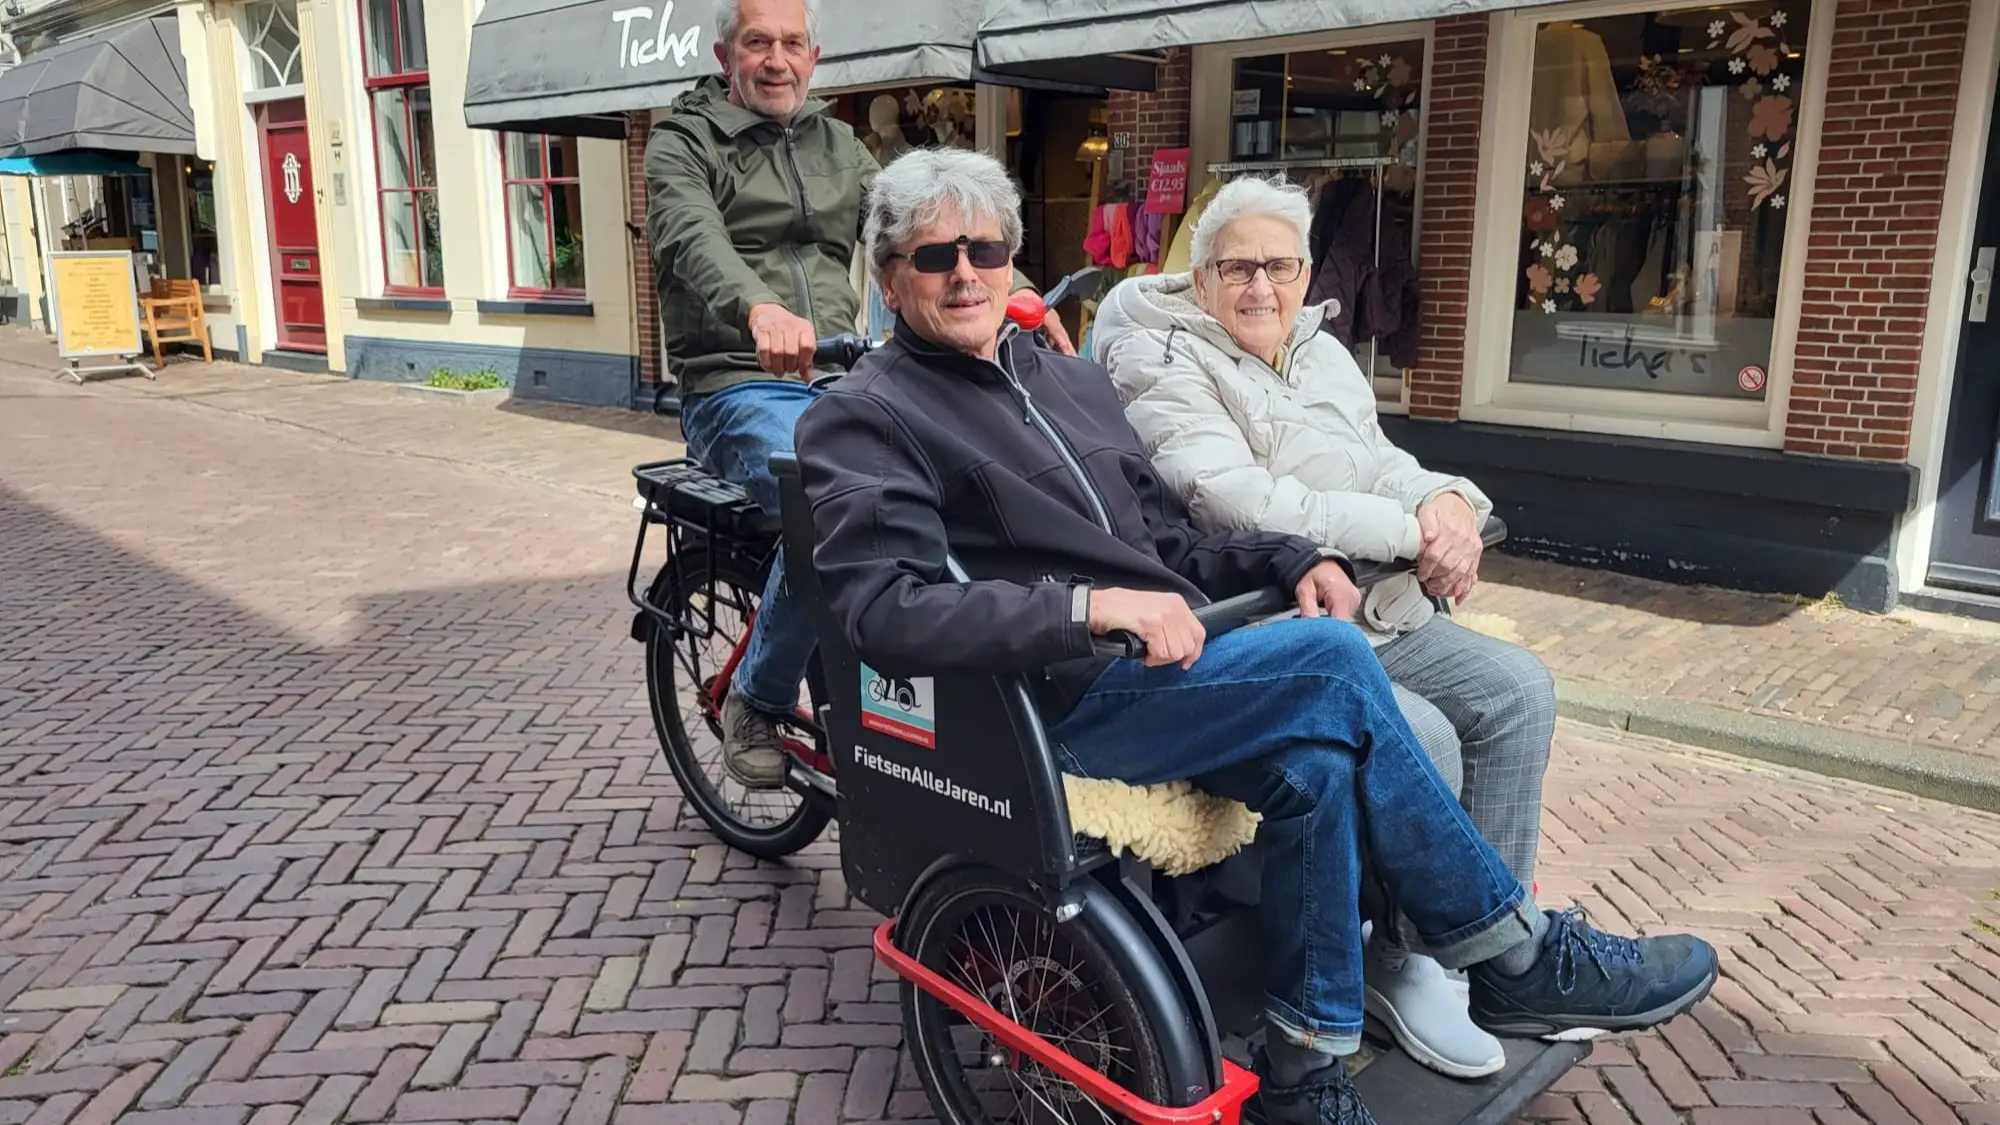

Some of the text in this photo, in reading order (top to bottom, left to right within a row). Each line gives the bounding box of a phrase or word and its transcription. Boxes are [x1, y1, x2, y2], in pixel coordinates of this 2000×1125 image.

[612, 0, 701, 69] Ticha
[1153, 160, 1186, 177] Sjaals
[854, 744, 1012, 819] FietsenAlleJaren.nl
